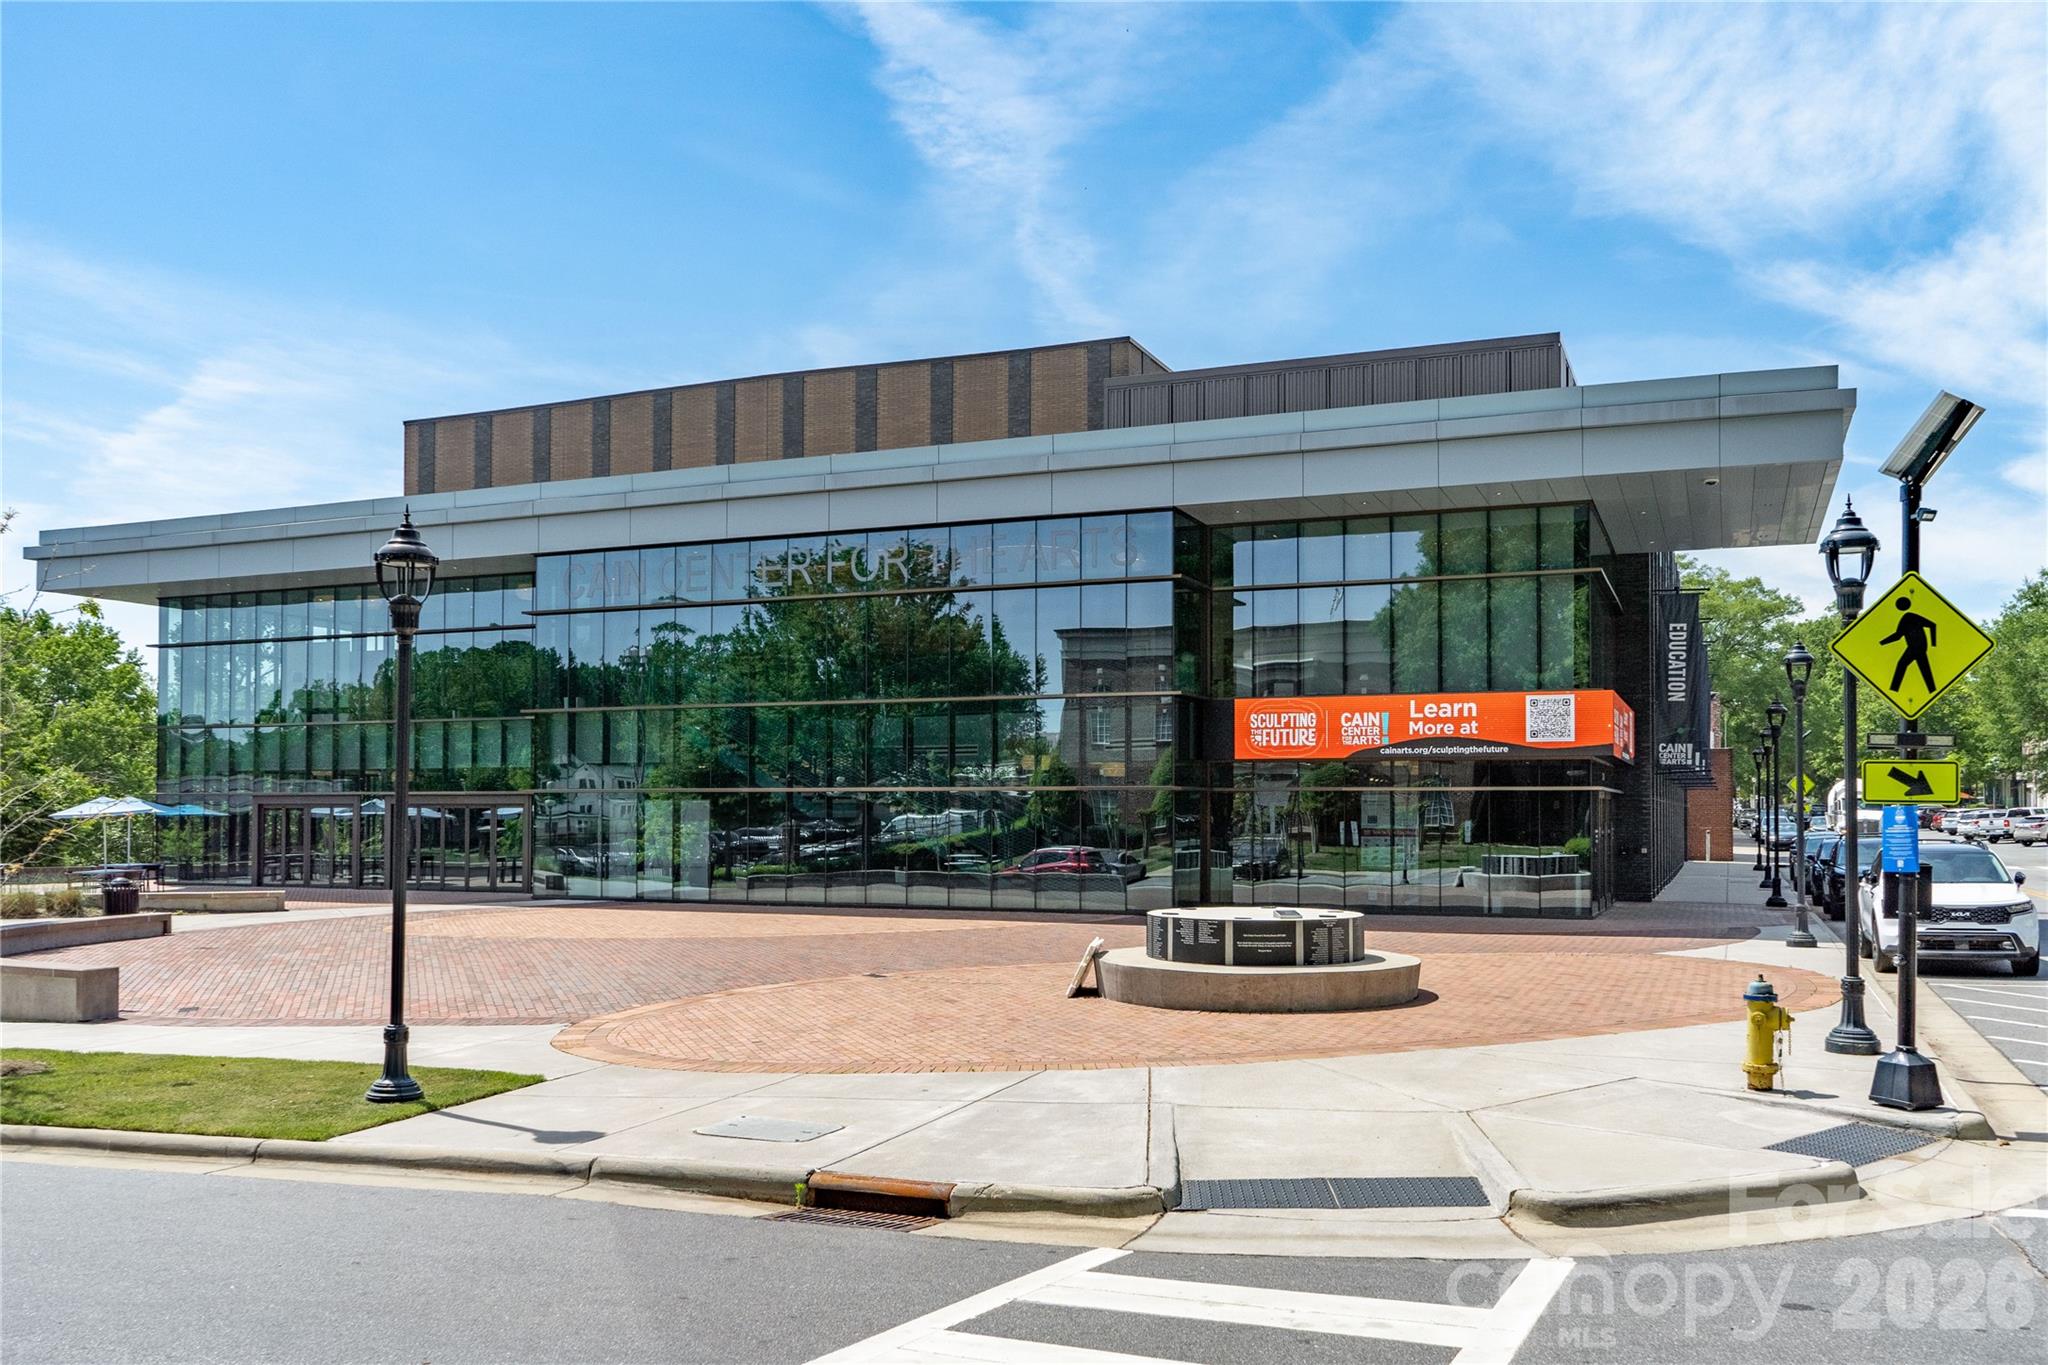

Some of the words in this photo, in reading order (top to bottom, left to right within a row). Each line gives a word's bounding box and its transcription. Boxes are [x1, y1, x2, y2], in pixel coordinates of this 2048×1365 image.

[563, 559, 647, 600] CAIN
[659, 548, 814, 595] CENTER
[828, 541, 911, 585] FOR
[921, 534, 1008, 577] THE
[1017, 525, 1138, 572] ARTS
[1668, 623, 1687, 701] EDUCATION
[1409, 700, 1477, 718] Learn
[1250, 713, 1316, 728] SCULPTING
[1409, 721, 1454, 735] More
[1460, 721, 1478, 734] at
[1262, 728, 1316, 746] FUTURE
[1341, 726, 1380, 736] CENTER
[1353, 736, 1380, 745] ARTS
[1380, 746, 1508, 755] cainarts.org/sculptingthefuture
